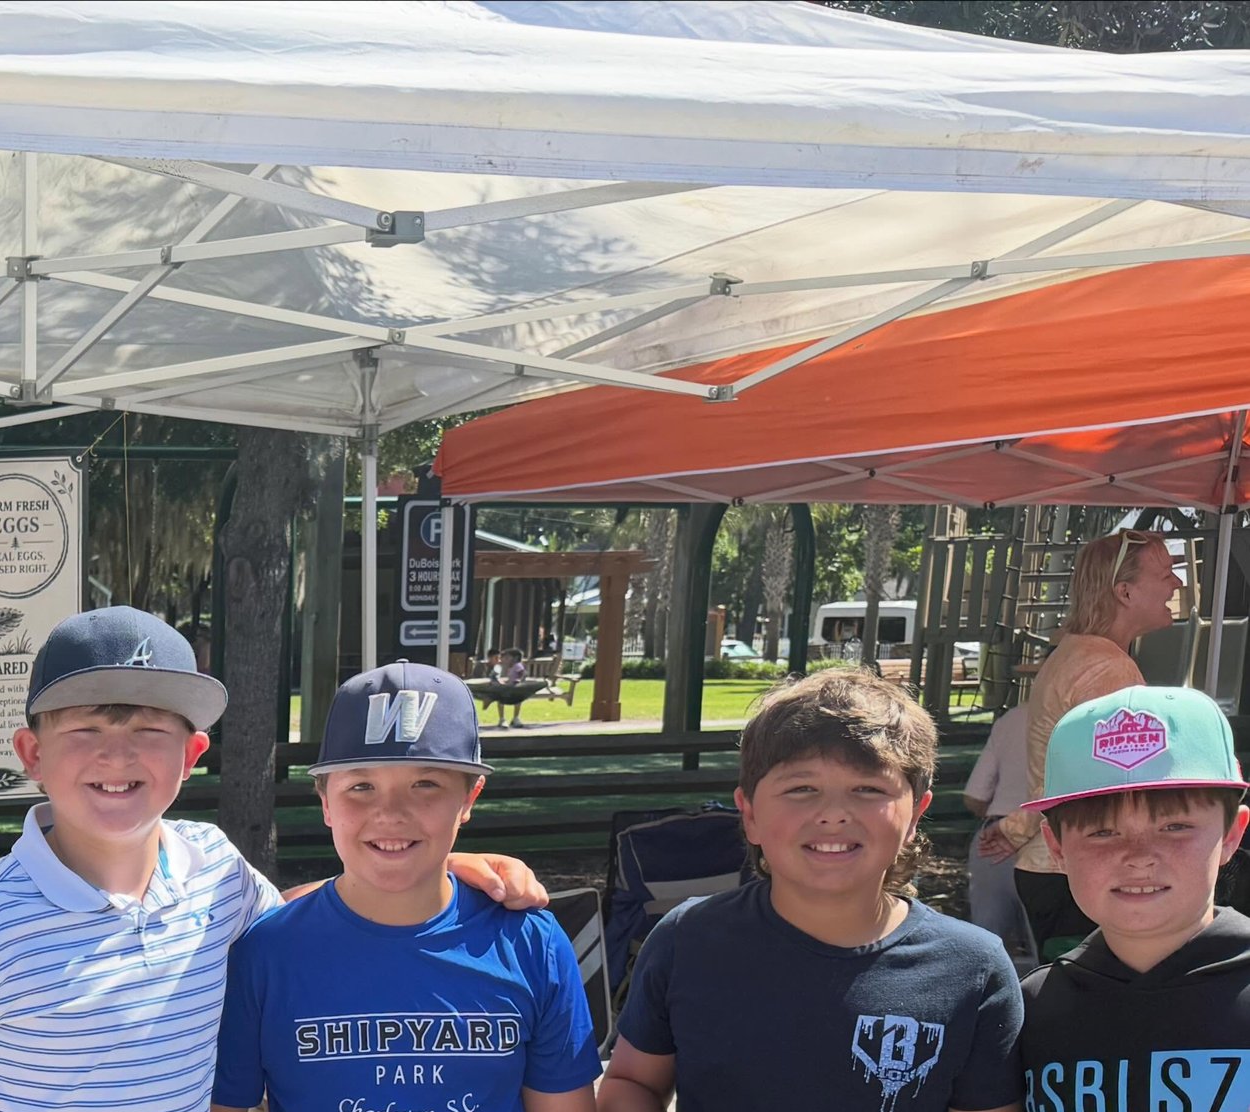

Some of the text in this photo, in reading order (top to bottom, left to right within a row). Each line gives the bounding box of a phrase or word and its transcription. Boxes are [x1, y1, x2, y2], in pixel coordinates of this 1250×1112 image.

[16, 500, 49, 511] FRESH
[17, 551, 45, 561] EGGS.
[19, 564, 49, 573] RIGHT.
[410, 559, 439, 568] DuBois
[410, 571, 416, 582] 3
[418, 571, 439, 581] HOUR
[7, 709, 26, 717] allow
[365, 690, 438, 745] W
[1099, 733, 1160, 749] RIPKEN
[295, 1017, 520, 1058] SHIPYARD
[375, 1064, 444, 1085] PARK
